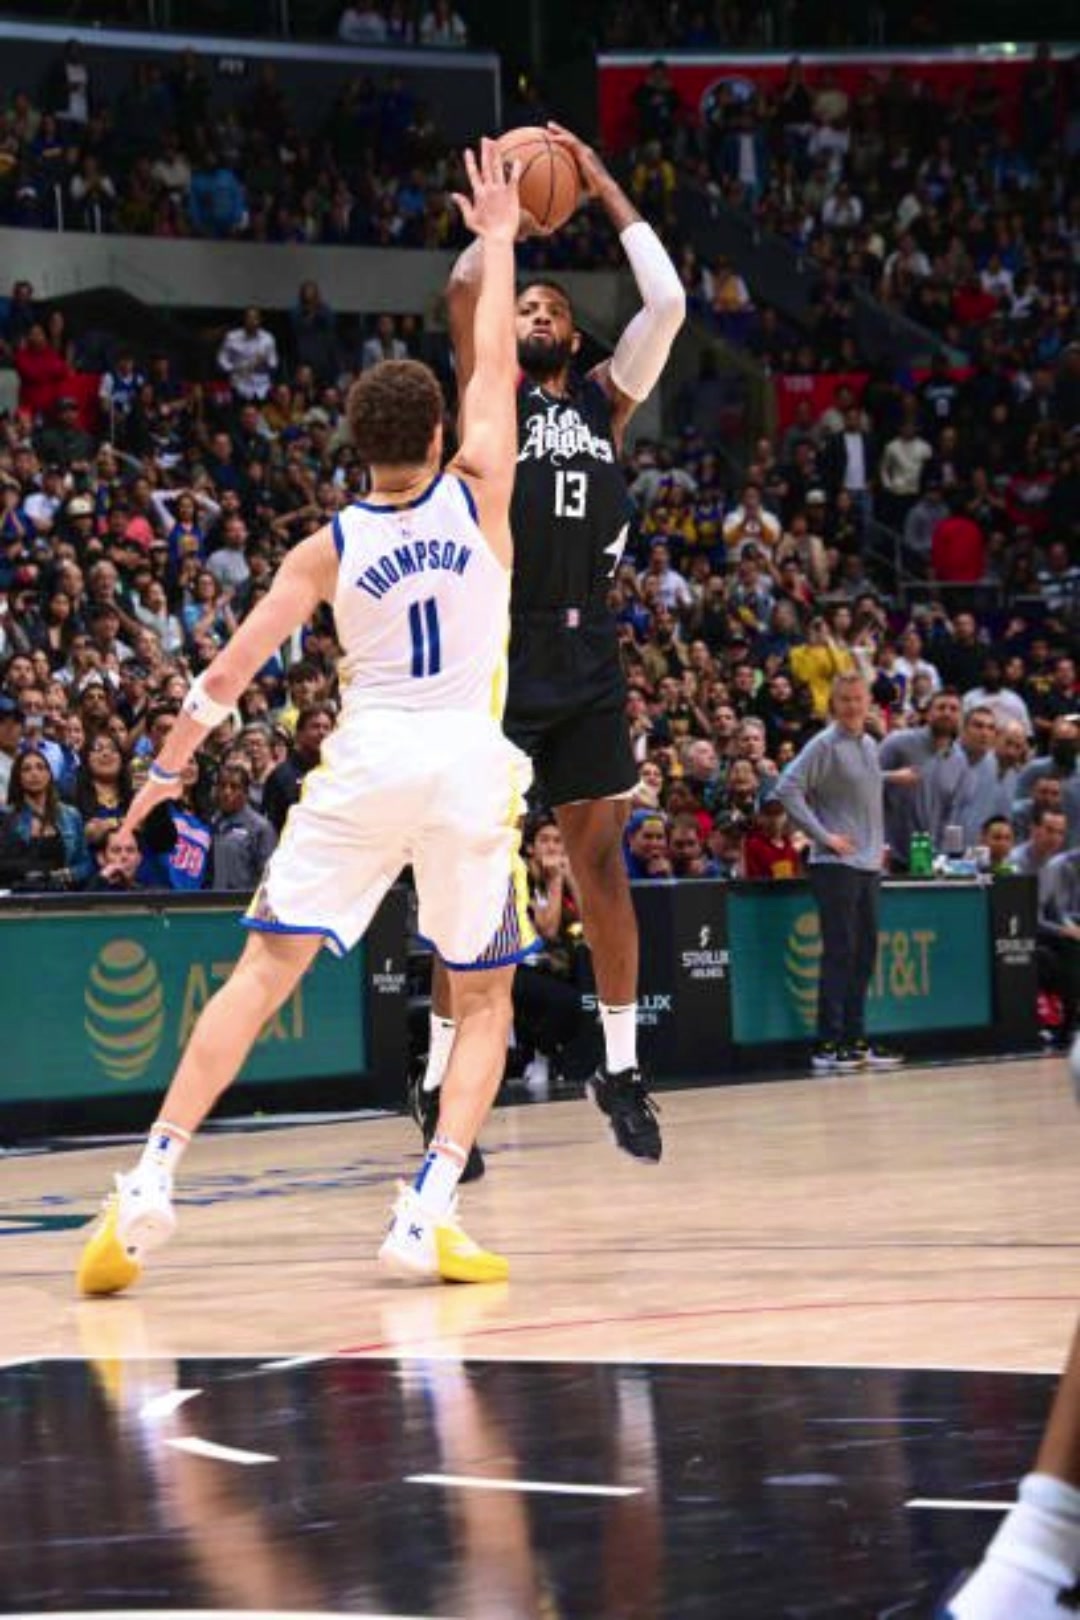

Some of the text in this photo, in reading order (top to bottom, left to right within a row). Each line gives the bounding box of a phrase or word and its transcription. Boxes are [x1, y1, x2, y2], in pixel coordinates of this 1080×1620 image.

[555, 471, 588, 518] 13
[355, 539, 472, 600] THOMPSON
[408, 595, 441, 678] 11
[868, 931, 938, 998] T&T
